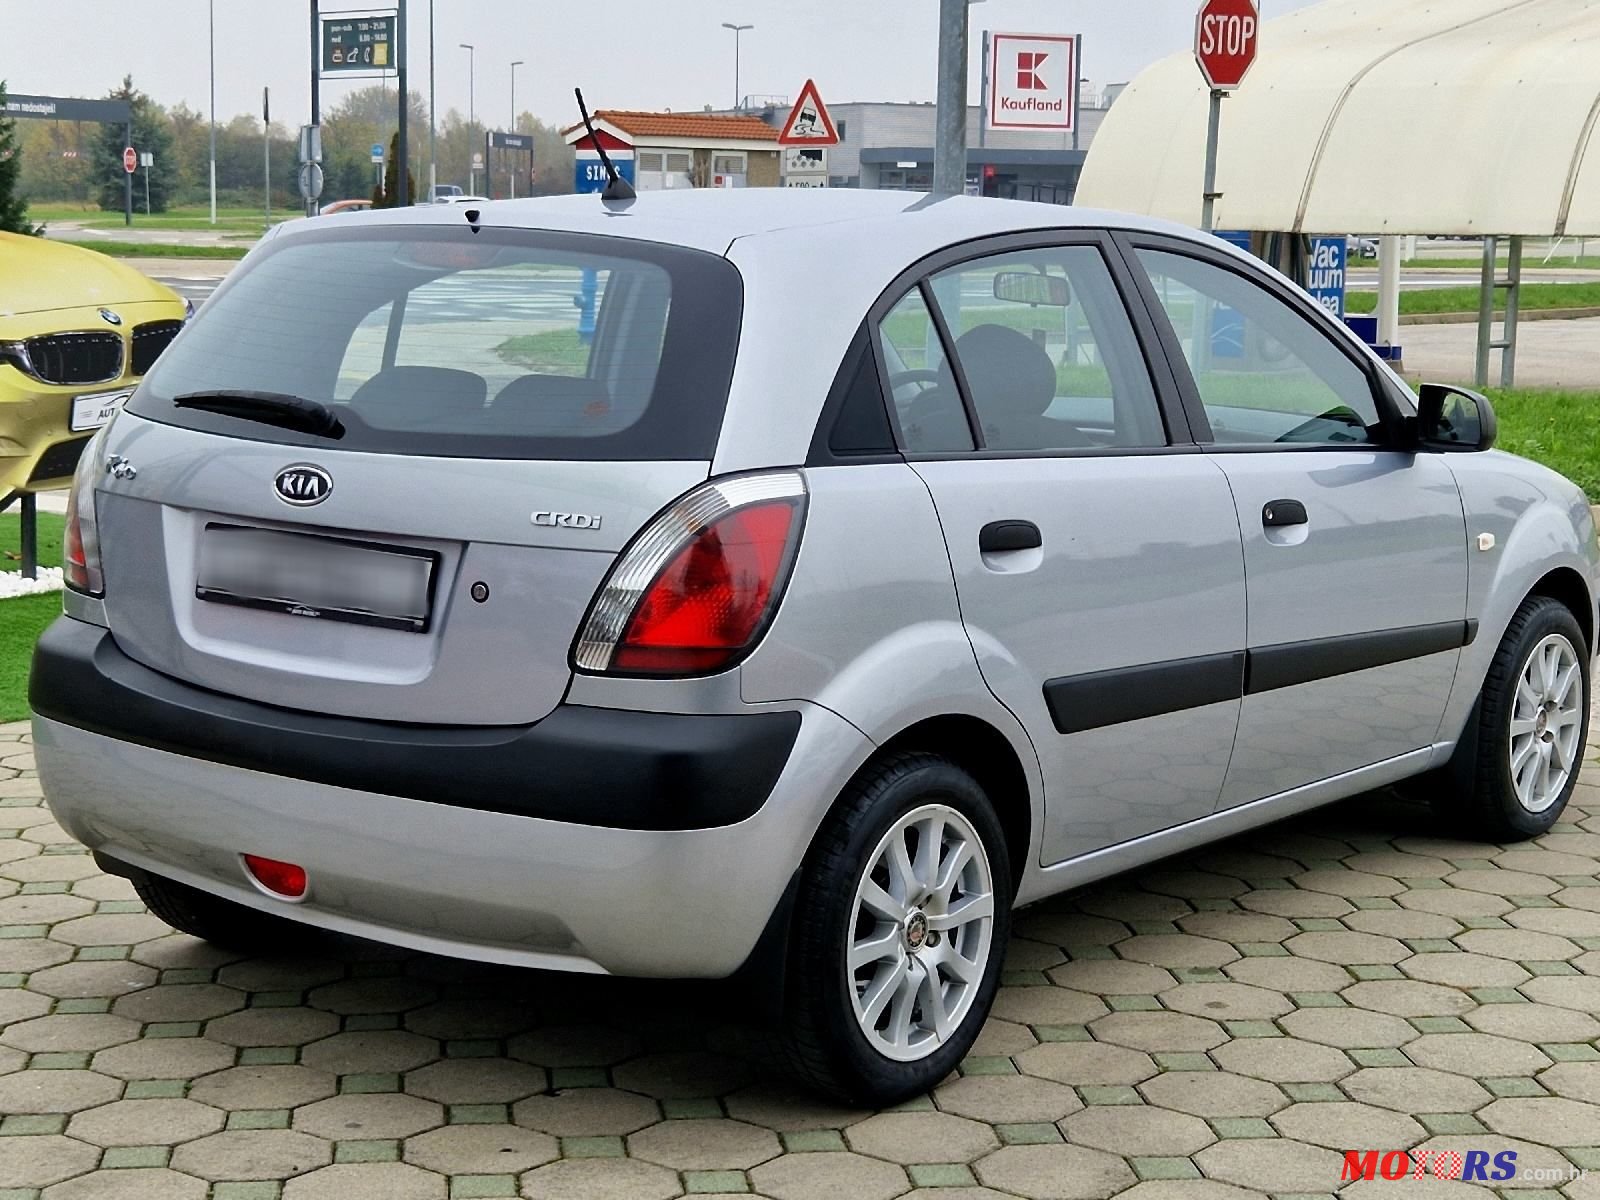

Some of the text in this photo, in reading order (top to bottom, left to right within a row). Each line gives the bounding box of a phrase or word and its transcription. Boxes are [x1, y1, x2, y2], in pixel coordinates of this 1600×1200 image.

[1202, 14, 1255, 55] STOP
[1001, 97, 1062, 111] Kaufland
[586, 165, 621, 181] SINS
[1309, 240, 1339, 268] Vac
[1308, 269, 1343, 289] uum
[1312, 291, 1340, 316] lea
[282, 474, 319, 497] KIA
[530, 511, 602, 530] CRDi
